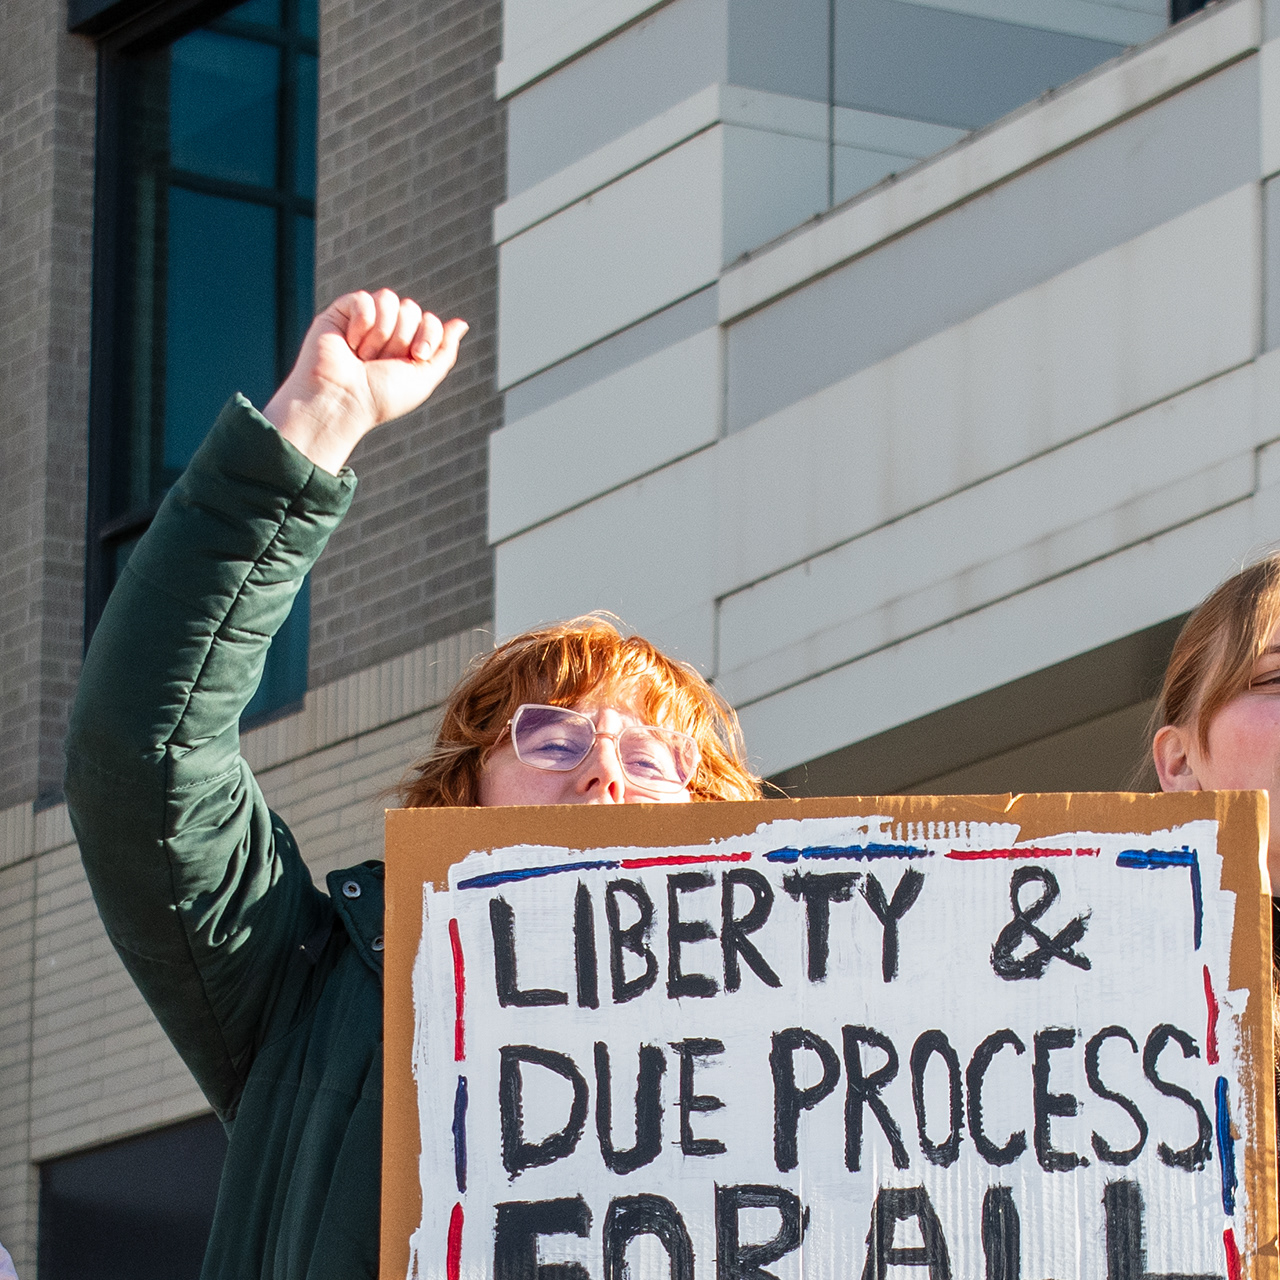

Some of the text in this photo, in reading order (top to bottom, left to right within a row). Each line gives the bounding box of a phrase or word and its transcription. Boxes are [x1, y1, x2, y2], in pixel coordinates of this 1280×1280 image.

[489, 866, 1091, 1009] LIBERTY &
[499, 1024, 1212, 1181] DUE PROCESS
